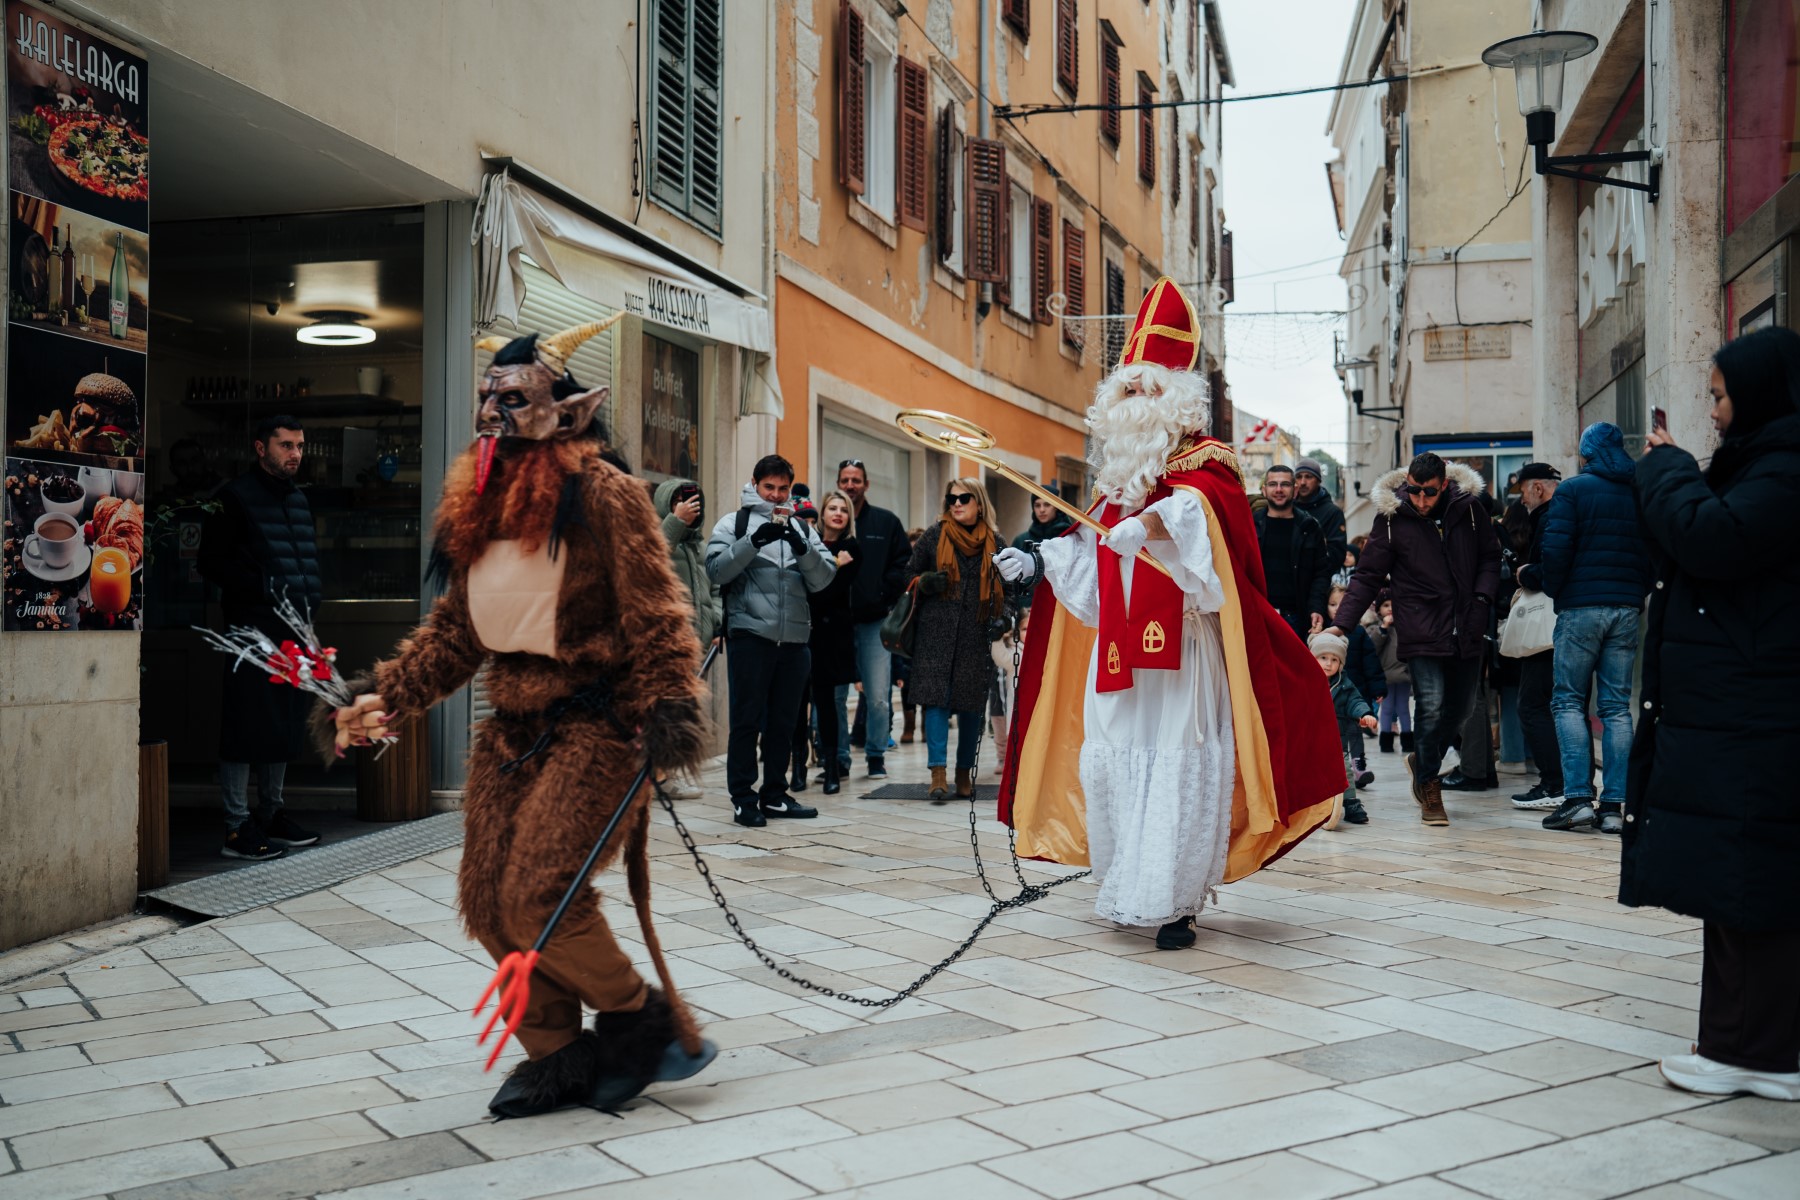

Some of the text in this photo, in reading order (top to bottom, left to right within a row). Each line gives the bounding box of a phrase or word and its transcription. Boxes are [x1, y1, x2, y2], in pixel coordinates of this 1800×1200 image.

[16, 12, 139, 105] KALELARGA
[1578, 139, 1645, 329] BIPA
[648, 276, 710, 334] KALELARGA
[653, 368, 684, 399] Buffet
[644, 402, 691, 440] Kalelarga
[16, 600, 67, 618] Jamnica
[35, 591, 51, 602] 1828
